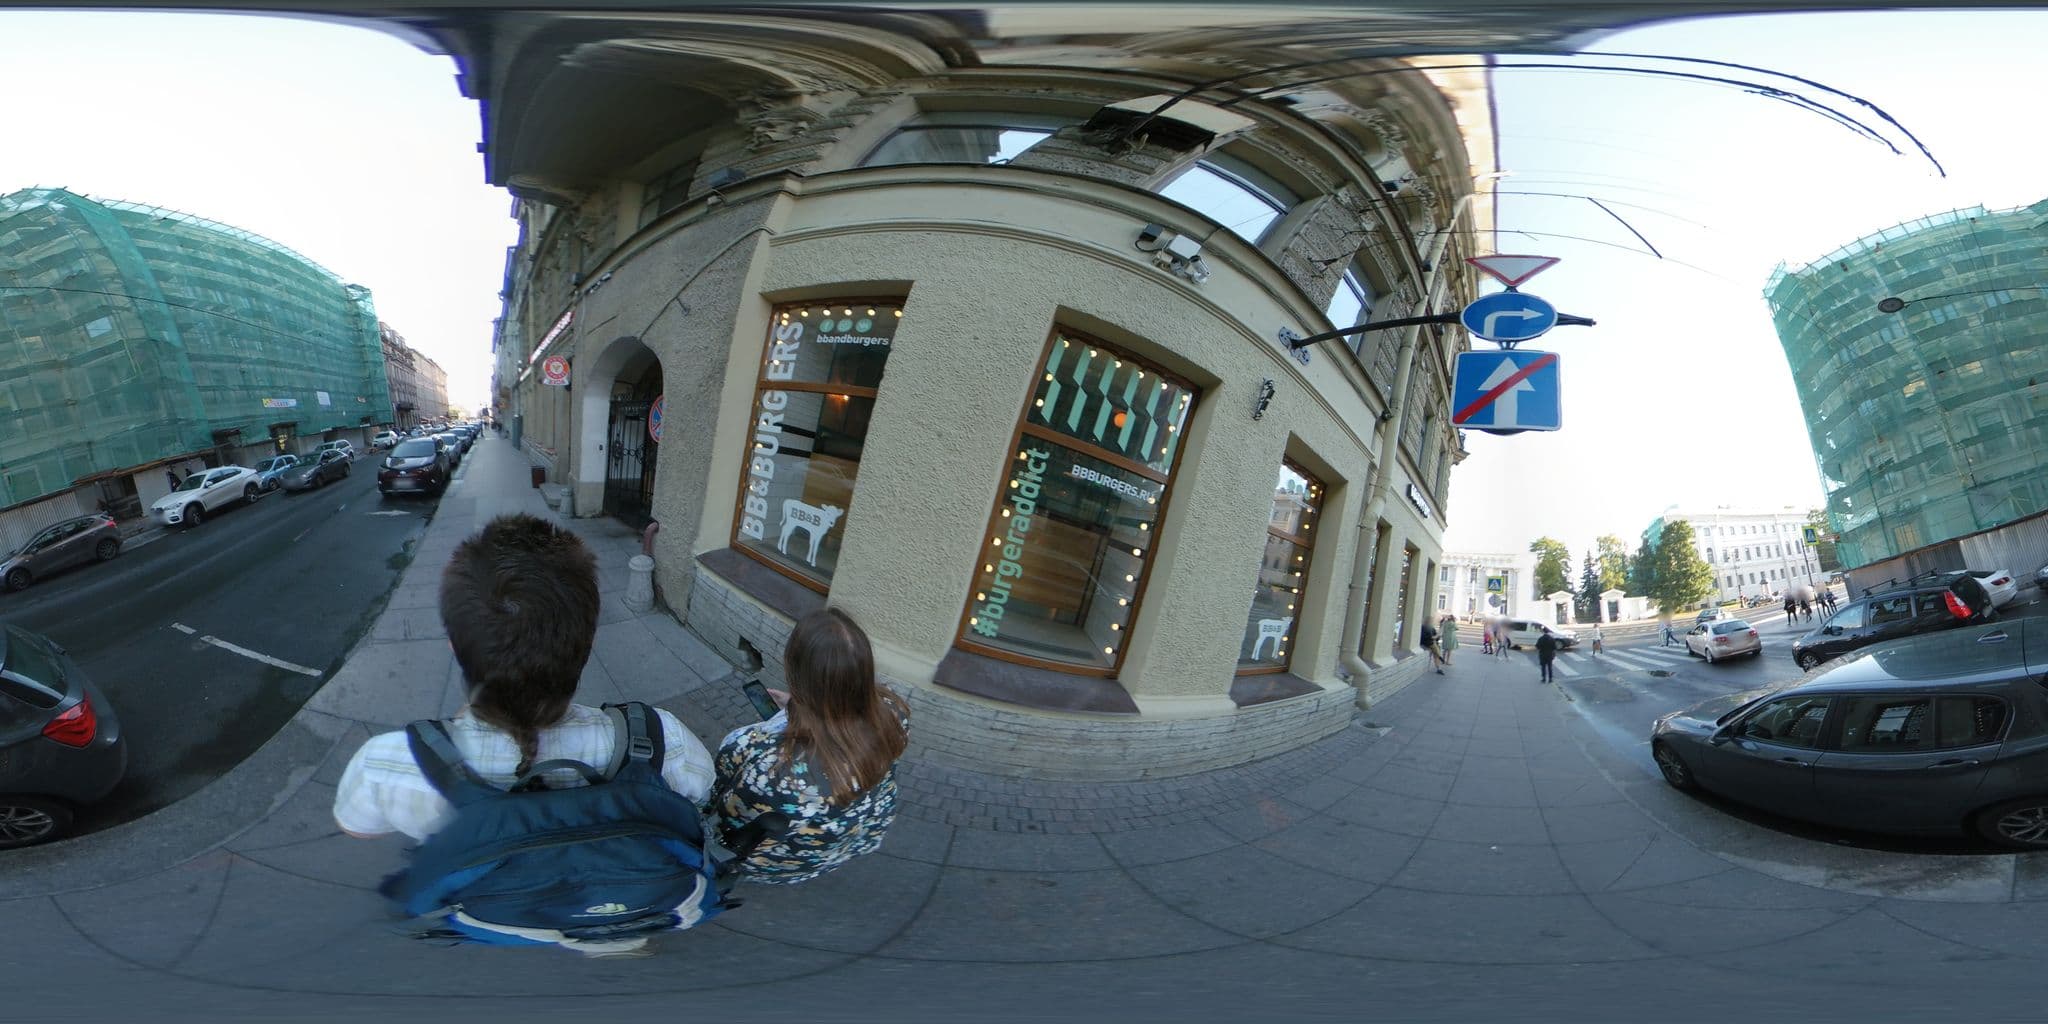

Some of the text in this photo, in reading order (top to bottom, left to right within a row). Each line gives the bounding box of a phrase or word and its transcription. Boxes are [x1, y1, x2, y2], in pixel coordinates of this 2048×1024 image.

[816, 334, 889, 346] bbandburgers
[743, 321, 805, 540] BB&BURGERS
[790, 507, 821, 527] BB&B
[973, 447, 1050, 638] #burgeraddict
